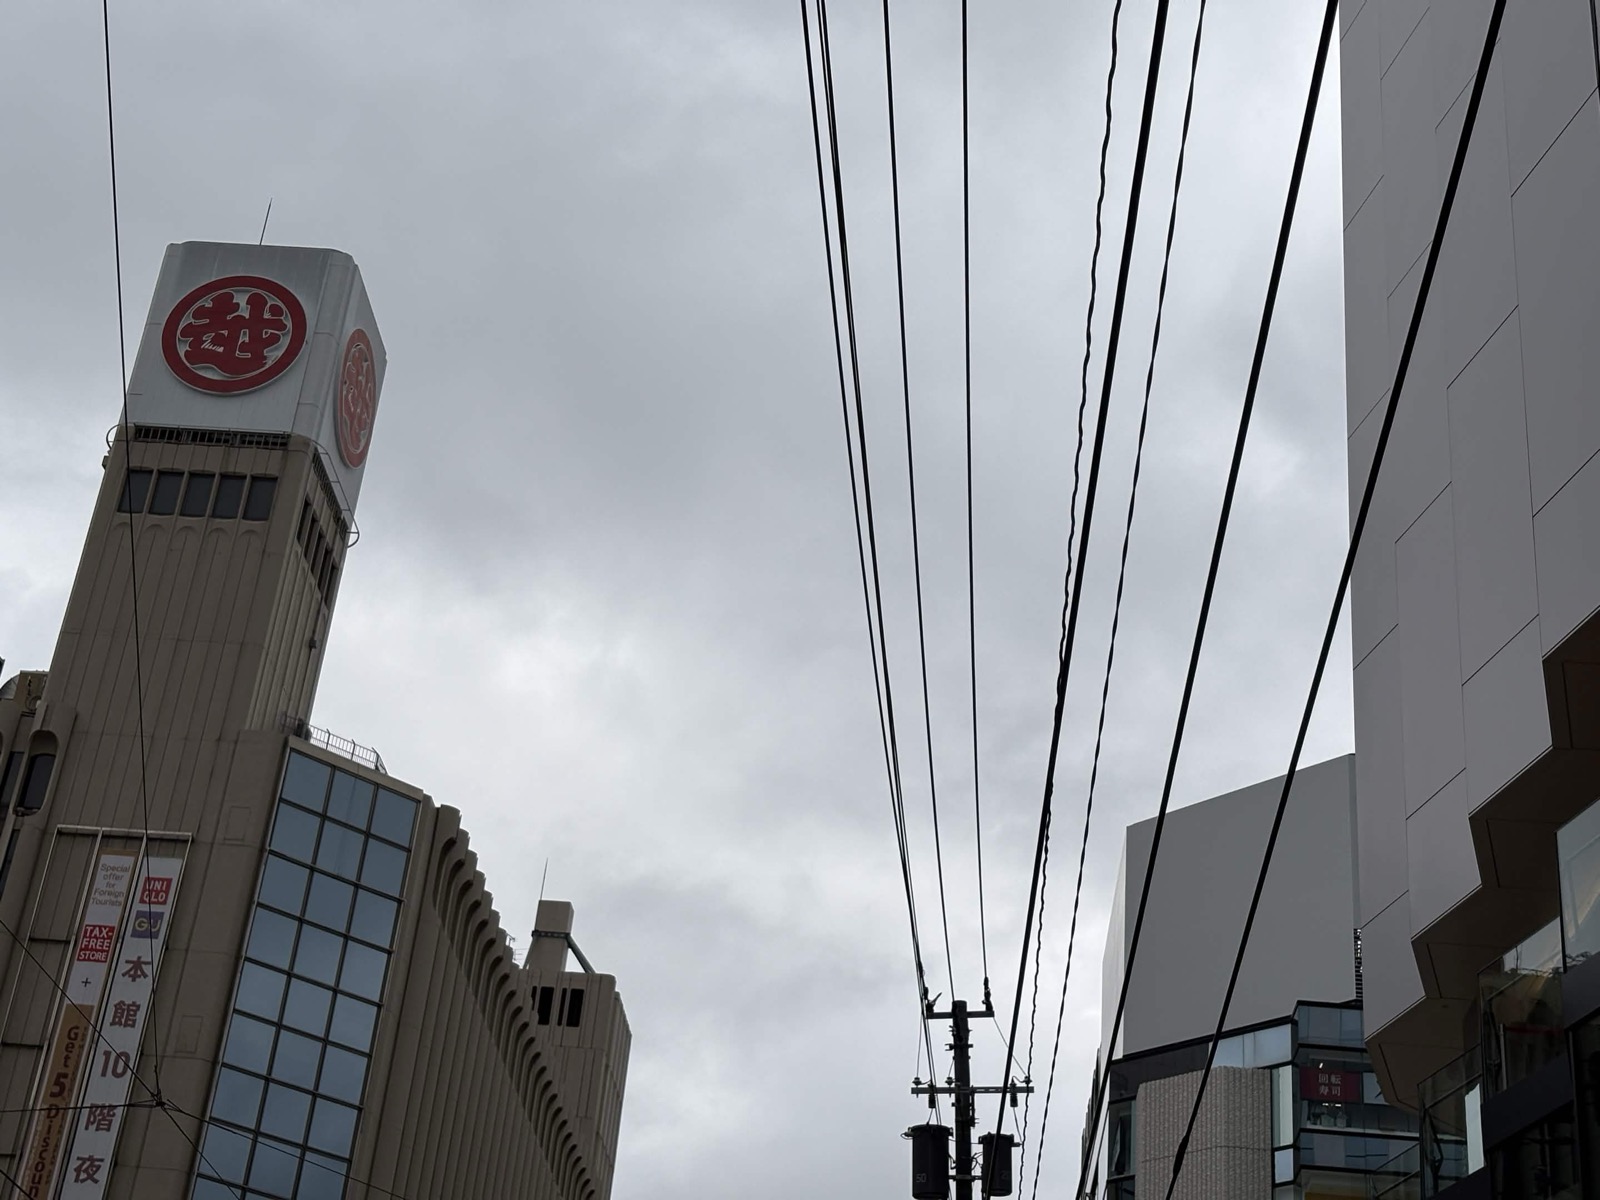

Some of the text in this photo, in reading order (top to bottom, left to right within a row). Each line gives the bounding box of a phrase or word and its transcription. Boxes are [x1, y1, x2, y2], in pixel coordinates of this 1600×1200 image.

[100, 863, 131, 873] Special
[103, 873, 124, 881] offer
[145, 880, 167, 891] UNI
[93, 888, 125, 898] Foreign
[143, 891, 166, 903] QLO
[91, 897, 122, 907] Tourists
[135, 917, 161, 932] GU
[85, 925, 113, 938] TAX-
[81, 937, 110, 951] FREE
[78, 949, 108, 961] STORE
[63, 1026, 80, 1068] Get
[1318, 1073, 1342, 1085] 回転
[1319, 1086, 1341, 1097] 寿司
